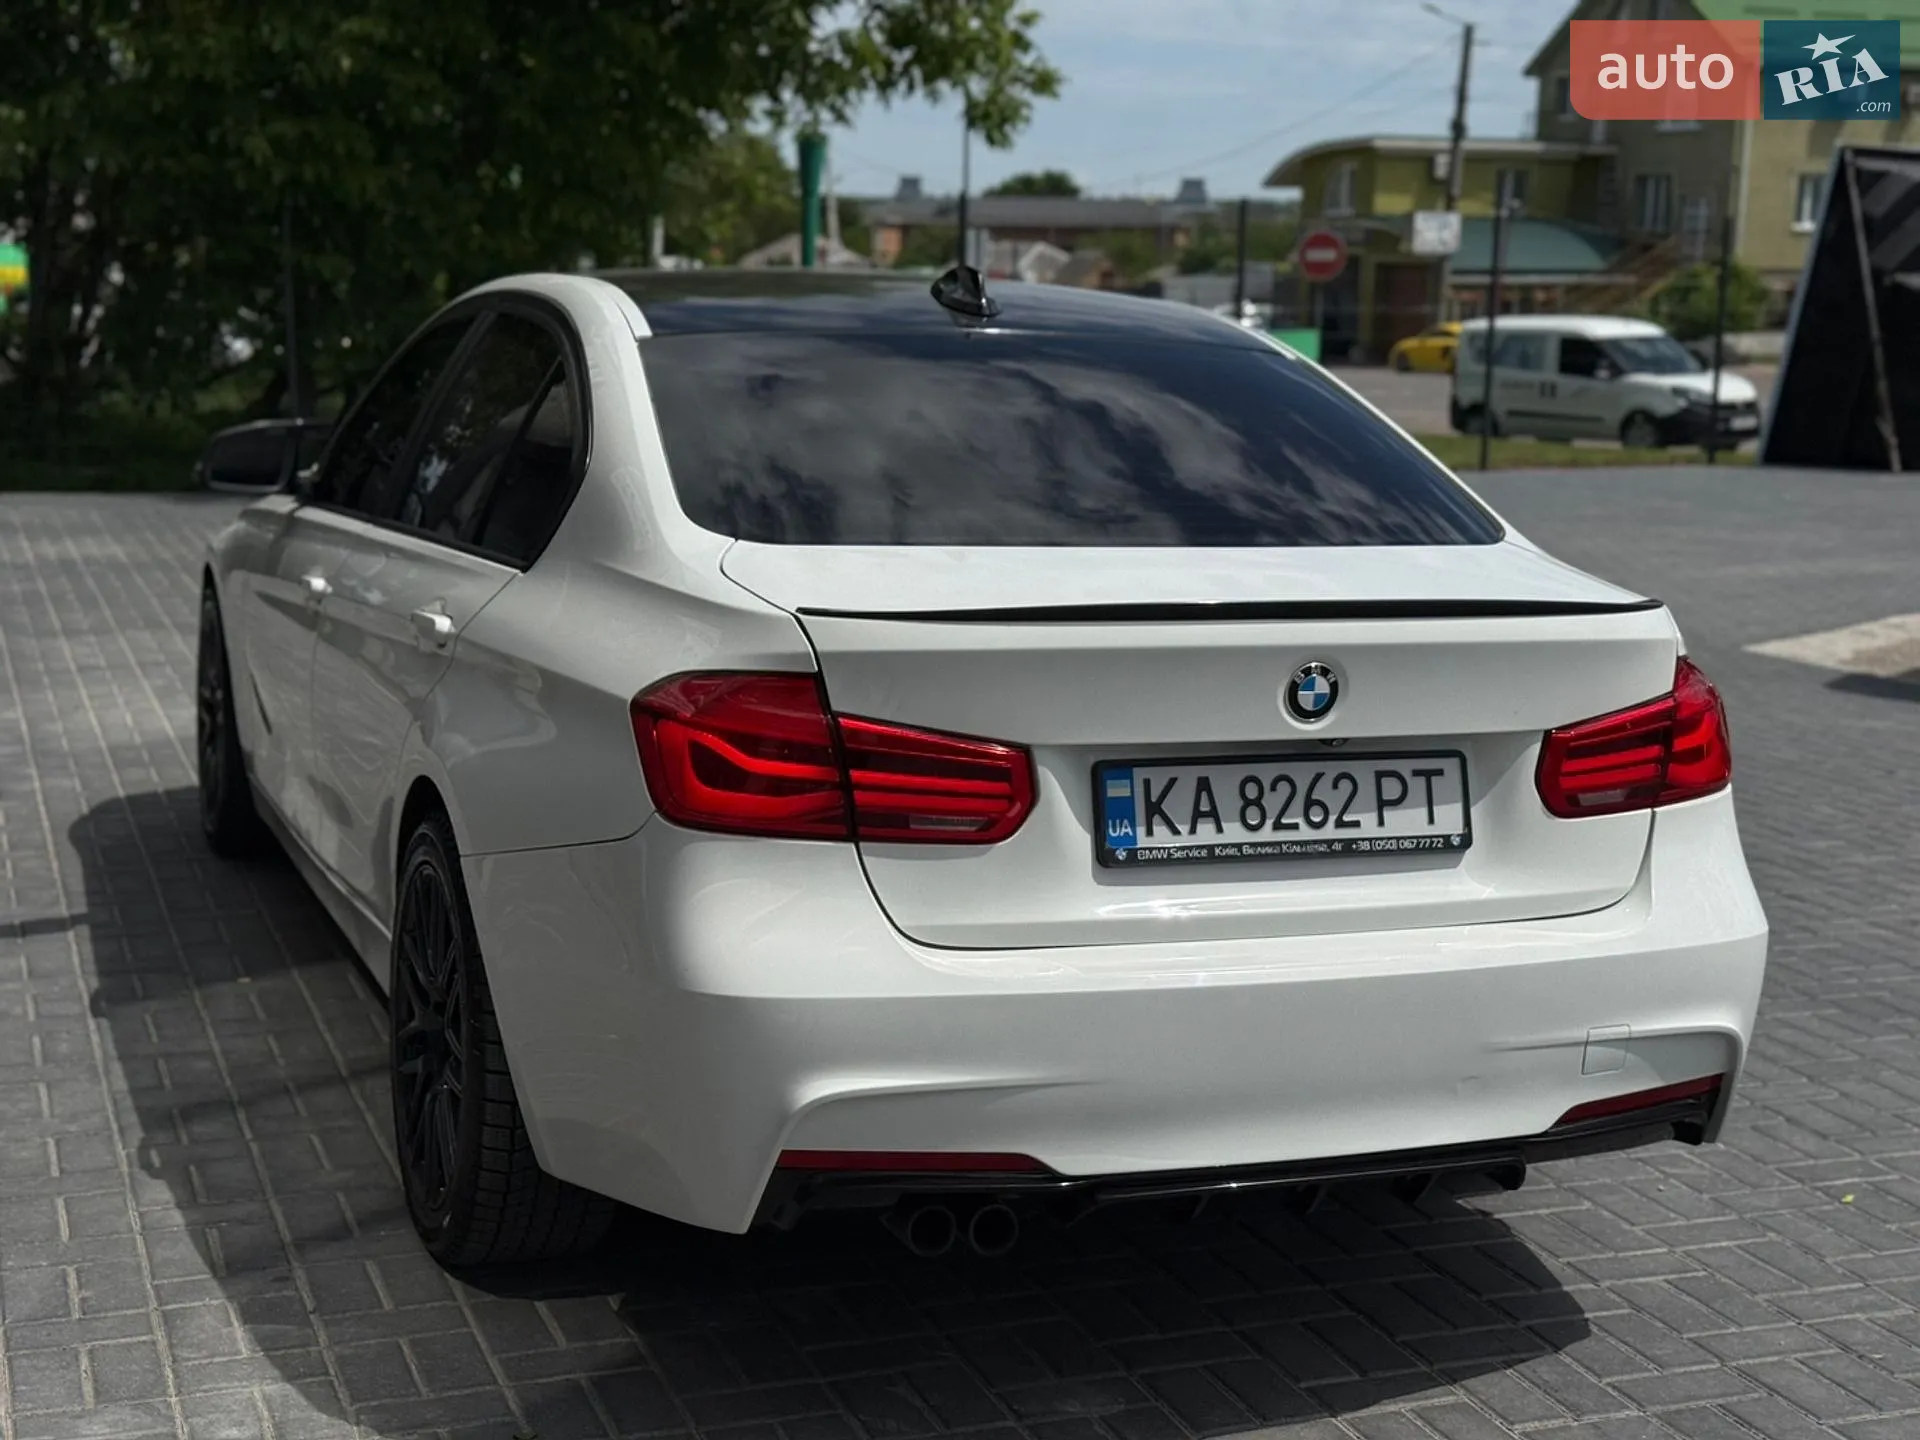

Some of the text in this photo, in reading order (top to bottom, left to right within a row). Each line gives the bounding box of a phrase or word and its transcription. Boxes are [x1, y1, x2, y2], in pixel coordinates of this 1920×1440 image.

[1142, 767, 1445, 838] KA 8262 PT
[1109, 818, 1132, 838] UA
[1137, 849, 1168, 860] BMW
[1170, 847, 1208, 859] Service
[1351, 840, 1371, 851] +38
